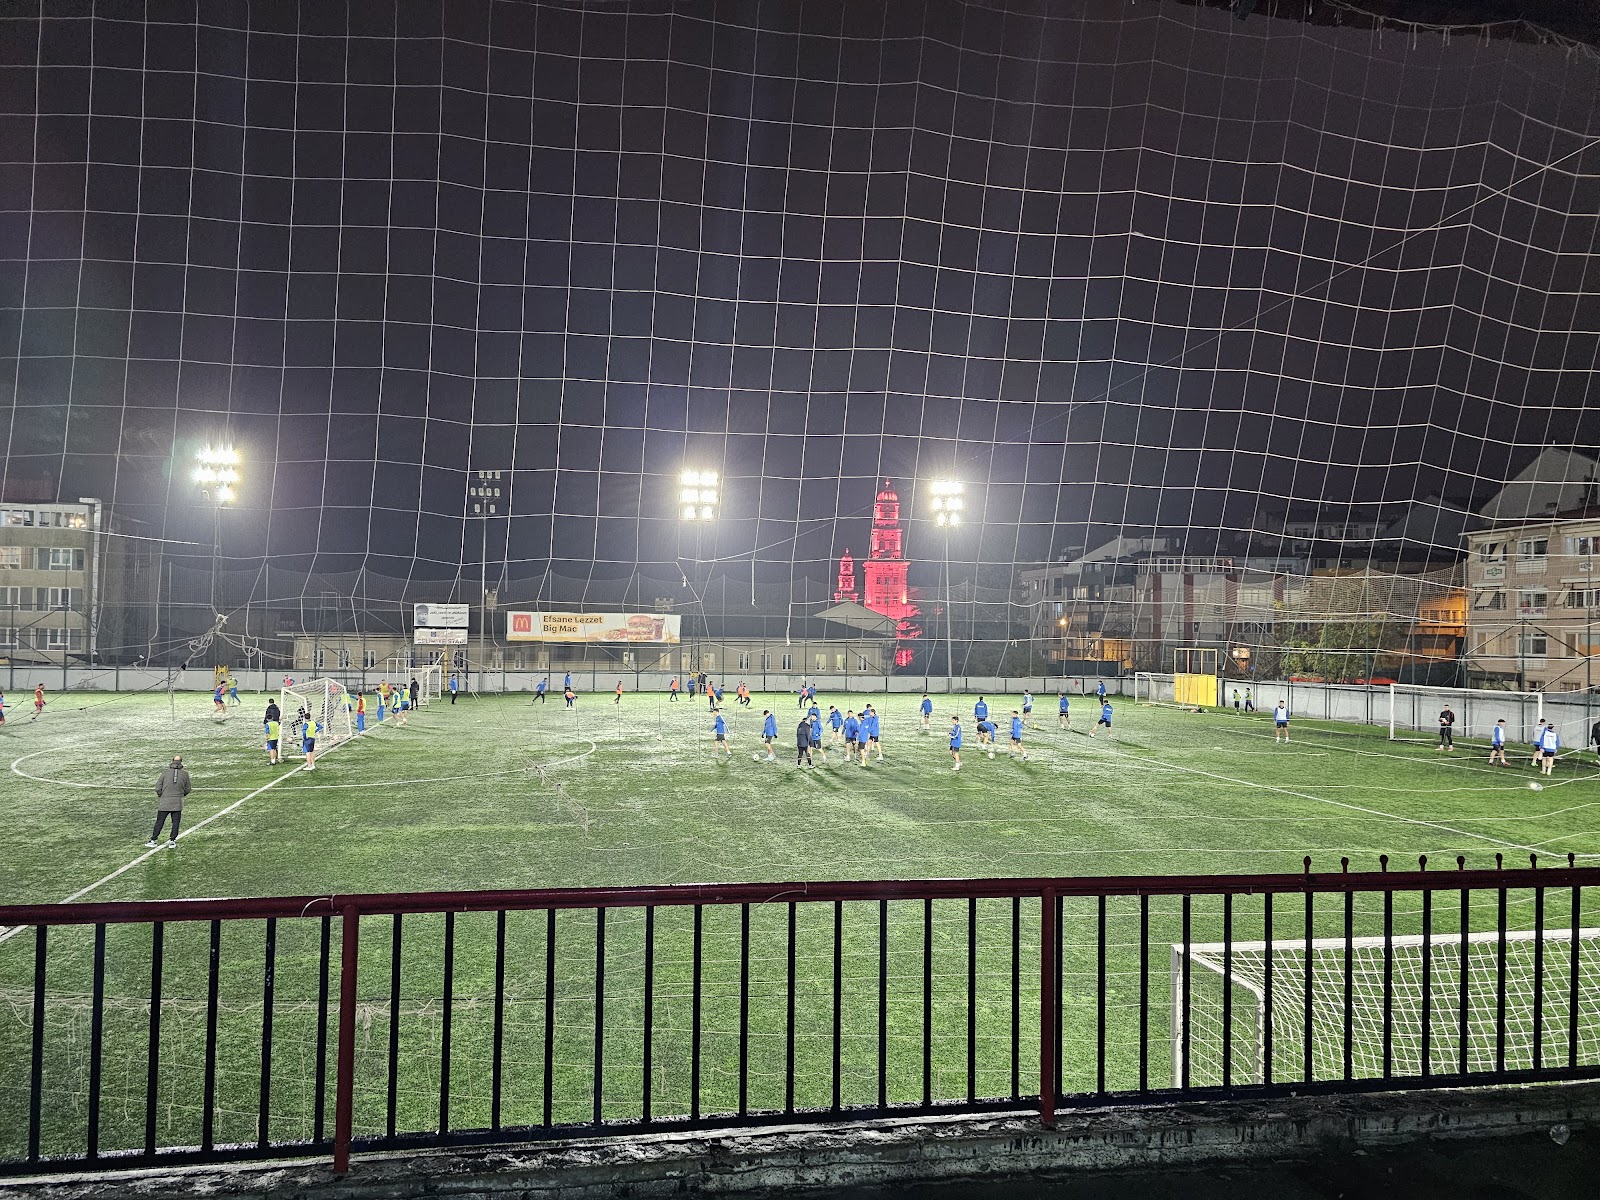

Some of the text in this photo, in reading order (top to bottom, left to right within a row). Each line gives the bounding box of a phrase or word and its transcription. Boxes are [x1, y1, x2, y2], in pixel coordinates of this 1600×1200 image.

[543, 615, 603, 624] Efsane Lezzet
[543, 624, 578, 633] Big Mac
